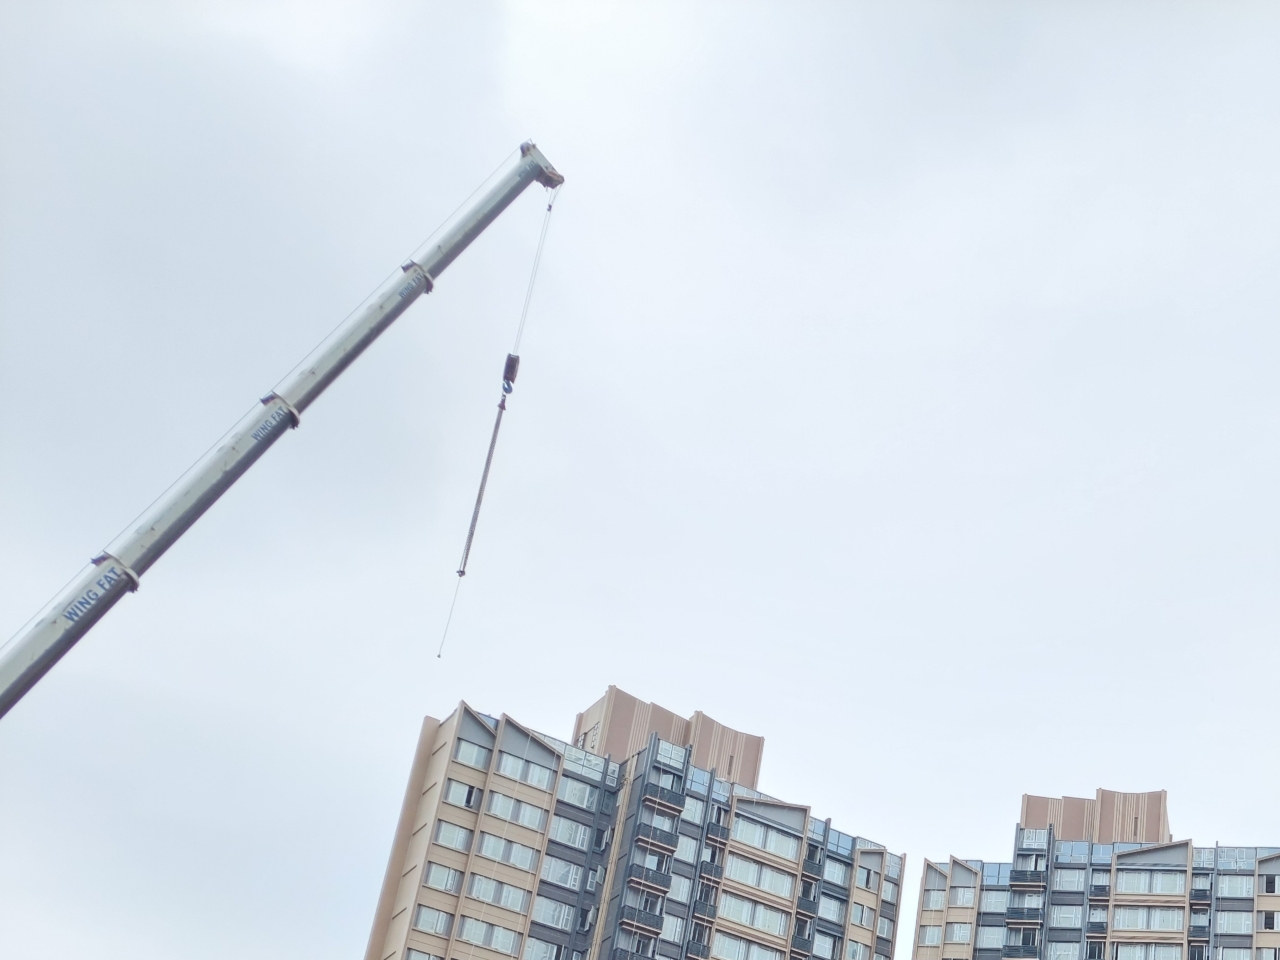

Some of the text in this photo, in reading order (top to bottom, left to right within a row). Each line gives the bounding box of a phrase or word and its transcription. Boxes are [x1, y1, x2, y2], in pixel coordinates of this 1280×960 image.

[251, 405, 287, 441] WING FAT
[63, 566, 121, 623] WING FAT
